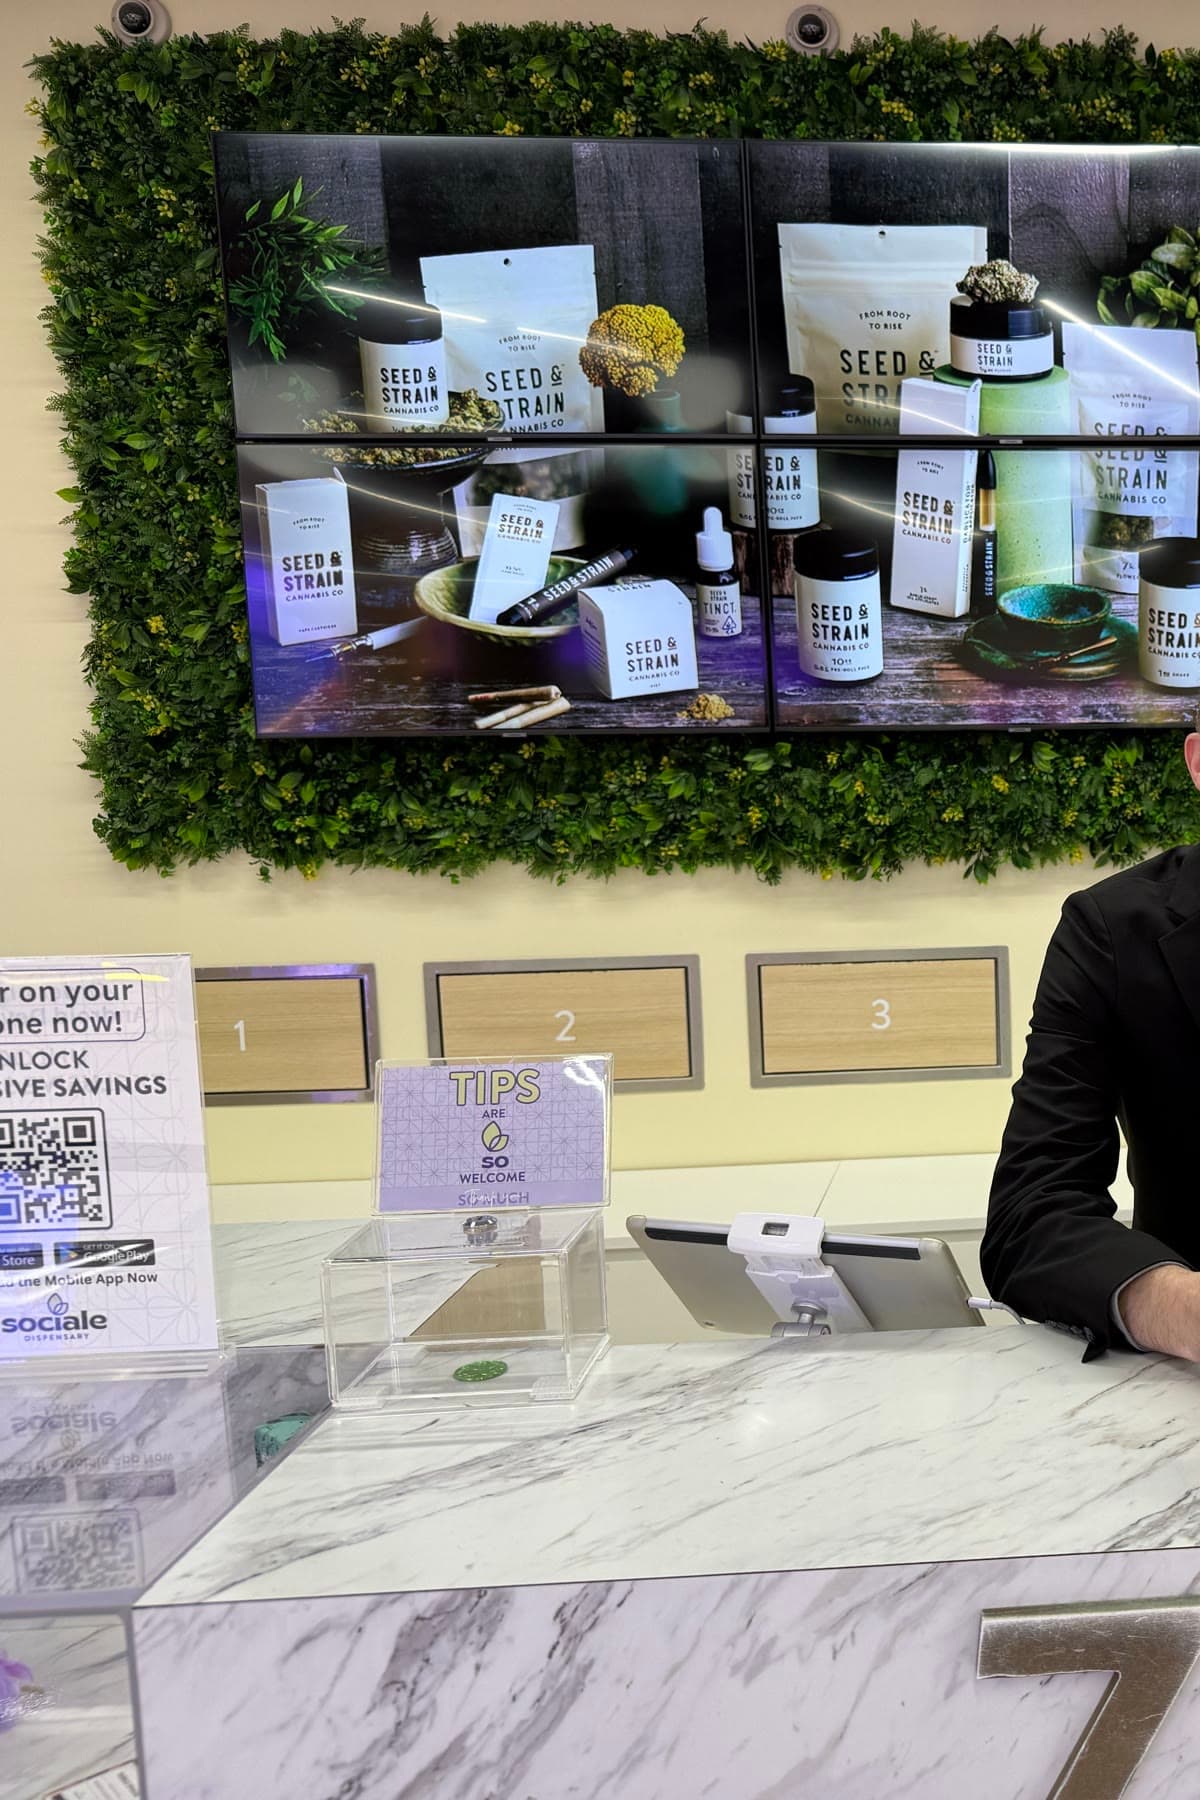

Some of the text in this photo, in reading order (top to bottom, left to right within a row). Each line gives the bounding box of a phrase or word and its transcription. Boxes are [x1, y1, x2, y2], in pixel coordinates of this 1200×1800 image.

[859, 310, 911, 320] FROM ROOT
[977, 343, 1013, 355] SEED &
[840, 349, 935, 376] SEED &
[977, 355, 1013, 366] STRAIN
[380, 366, 437, 385] SEED &
[485, 365, 563, 393] SEED &
[382, 384, 439, 404] STRAIN
[383, 404, 439, 414] CANNABIS CO
[551, 418, 564, 429] CO
[790, 455, 800, 472] &
[1095, 466, 1167, 489] STRAIN
[903, 491, 954, 516] SEED &
[1098, 491, 1167, 504] CANNABIS CO
[500, 513, 532, 527] SEED
[902, 510, 953, 535] STRAIN
[498, 523, 543, 540] STRAIN
[902, 529, 951, 545] CANNABIS CO
[282, 551, 342, 572] SEED &
[284, 570, 343, 592] STRAIN
[286, 591, 329, 602] CANNABIS
[811, 603, 868, 621] SEED &
[1149, 608, 1187, 629] SEED
[812, 622, 869, 641] STRAIN
[625, 636, 678, 656] SEED &
[813, 642, 869, 651] CANNABIS CO
[1148, 646, 1189, 658] CANNABIS
[627, 653, 679, 673] STRAIN
[629, 672, 668, 682] CANNABIS
[19, 983, 133, 1008] on your
[53, 1011, 122, 1033] now!
[871, 999, 891, 1029] 3
[555, 1010, 576, 1041] 2
[233, 1020, 246, 1051] 1
[53, 1076, 167, 1097] SAVINGS
[449, 1068, 541, 1106] TIPS
[482, 1109, 506, 1119] ARE
[481, 1156, 509, 1169] SO
[460, 1172, 526, 1184] WELCOME
[486, 1191, 529, 1205] MUCH
[2, 1255, 36, 1266] Store
[96, 1273, 124, 1286] App
[128, 1272, 158, 1283] Now
[1, 1311, 108, 1333] sociale
[24, 1333, 89, 1341] DISPENSARY
